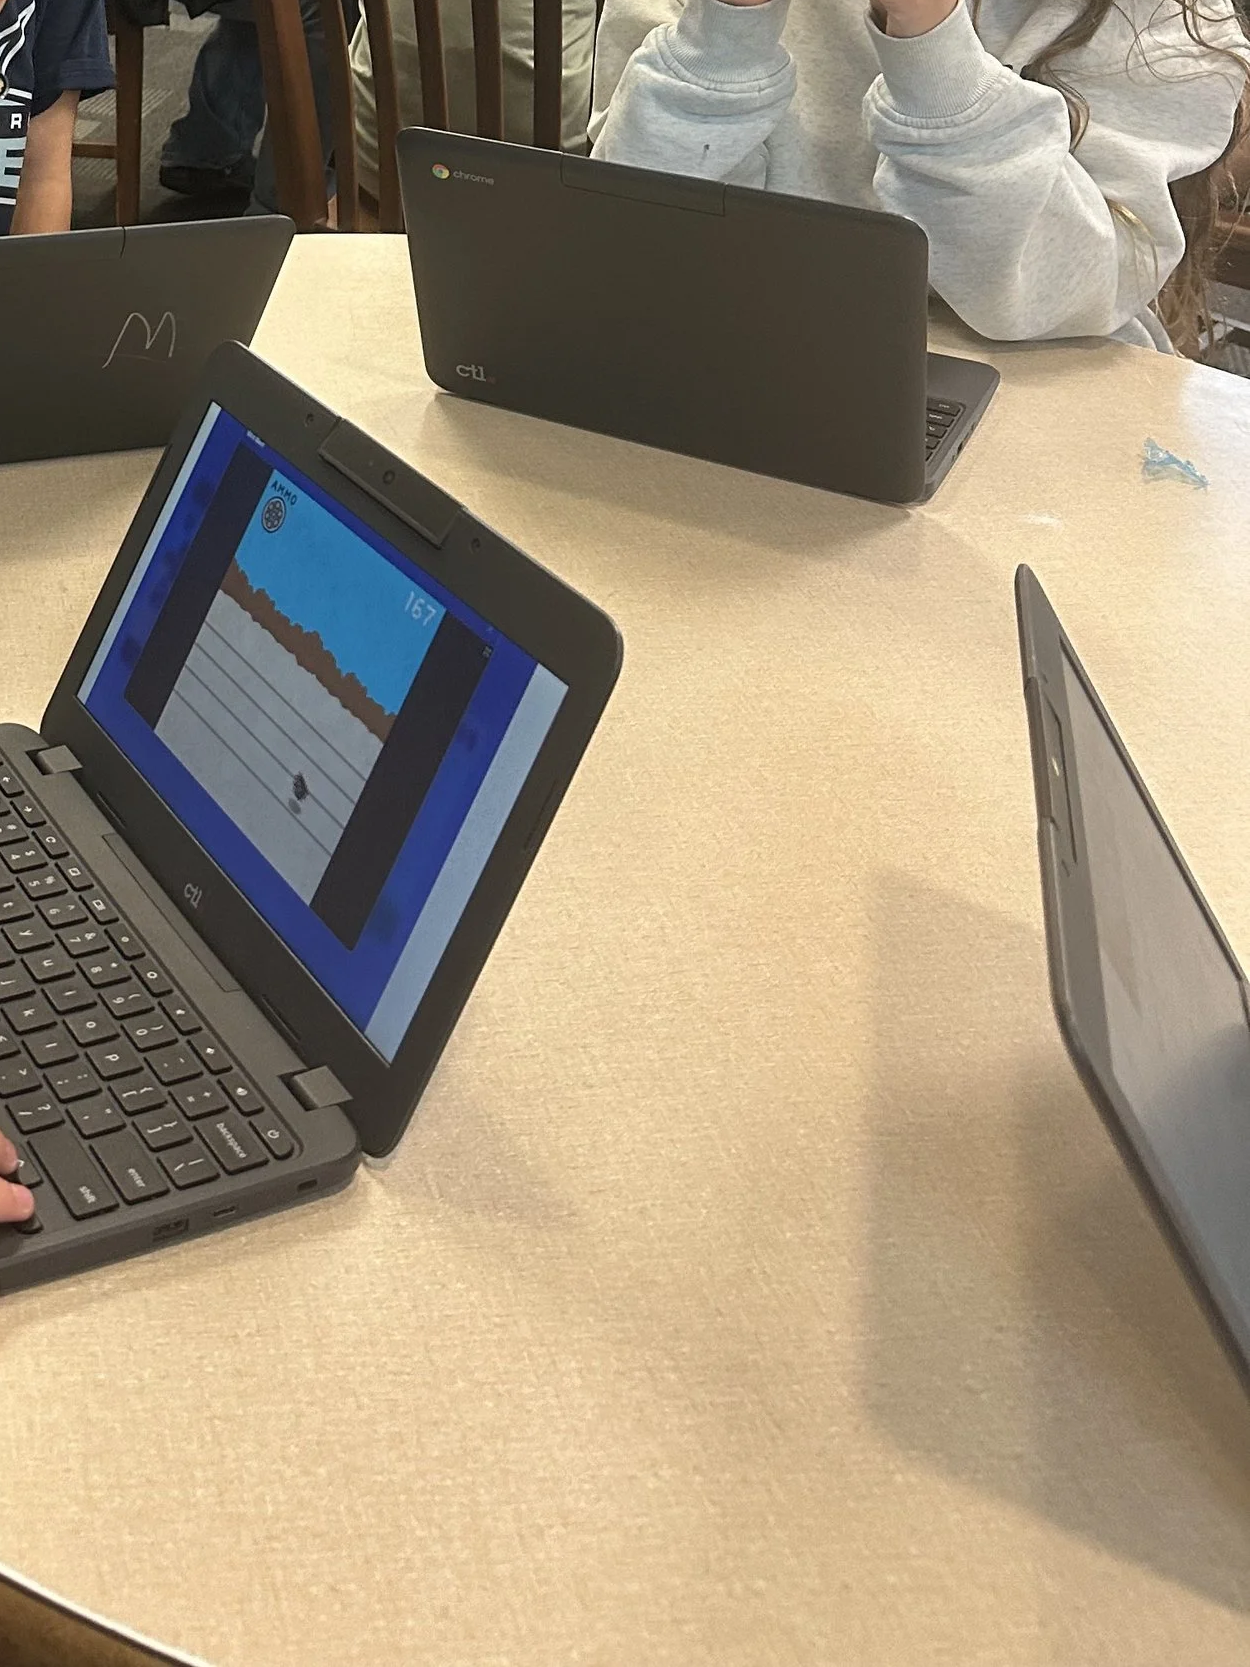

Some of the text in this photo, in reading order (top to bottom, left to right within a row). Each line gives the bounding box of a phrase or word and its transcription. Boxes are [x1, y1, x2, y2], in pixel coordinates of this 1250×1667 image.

[452, 170, 495, 186] chrome
[270, 479, 298, 507] AMMO
[403, 590, 438, 627] 167
[217, 1123, 246, 1157] backspace
[128, 1169, 145, 1186] enter
[80, 1186, 96, 1203] shift
